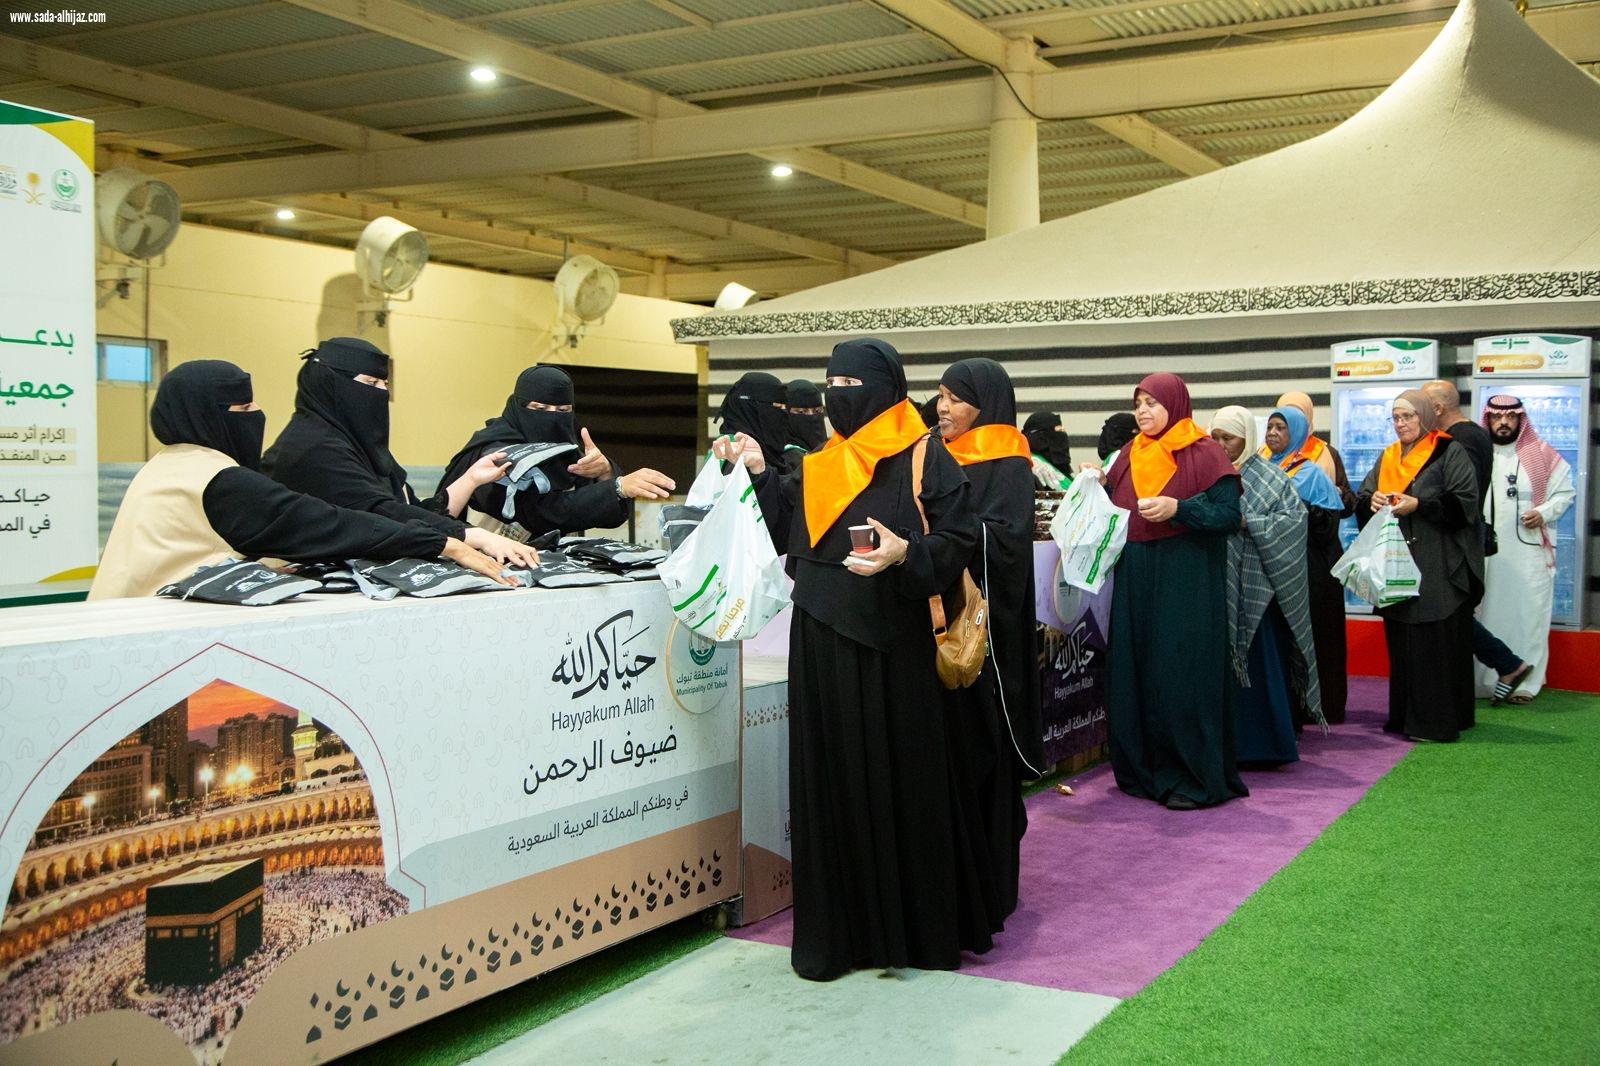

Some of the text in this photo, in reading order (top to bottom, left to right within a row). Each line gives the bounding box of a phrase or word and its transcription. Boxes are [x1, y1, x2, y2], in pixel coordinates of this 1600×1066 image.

[0, 329, 74, 355] بدع
[0, 371, 74, 407] جمعي
[40, 427, 66, 446] إكرام
[42, 452, 67, 464] من
[29, 513, 51, 539] في
[676, 672, 693, 685] تبوك
[676, 684, 706, 696] Municipality
[714, 679, 728, 690] Tabuk
[693, 669, 714, 681] منطقة
[551, 694, 655, 733] Hayyakum Allah
[523, 724, 677, 795] ضيوف الرحمن
[507, 785, 690, 855] في وطنكم المملكة العربية السعودية
